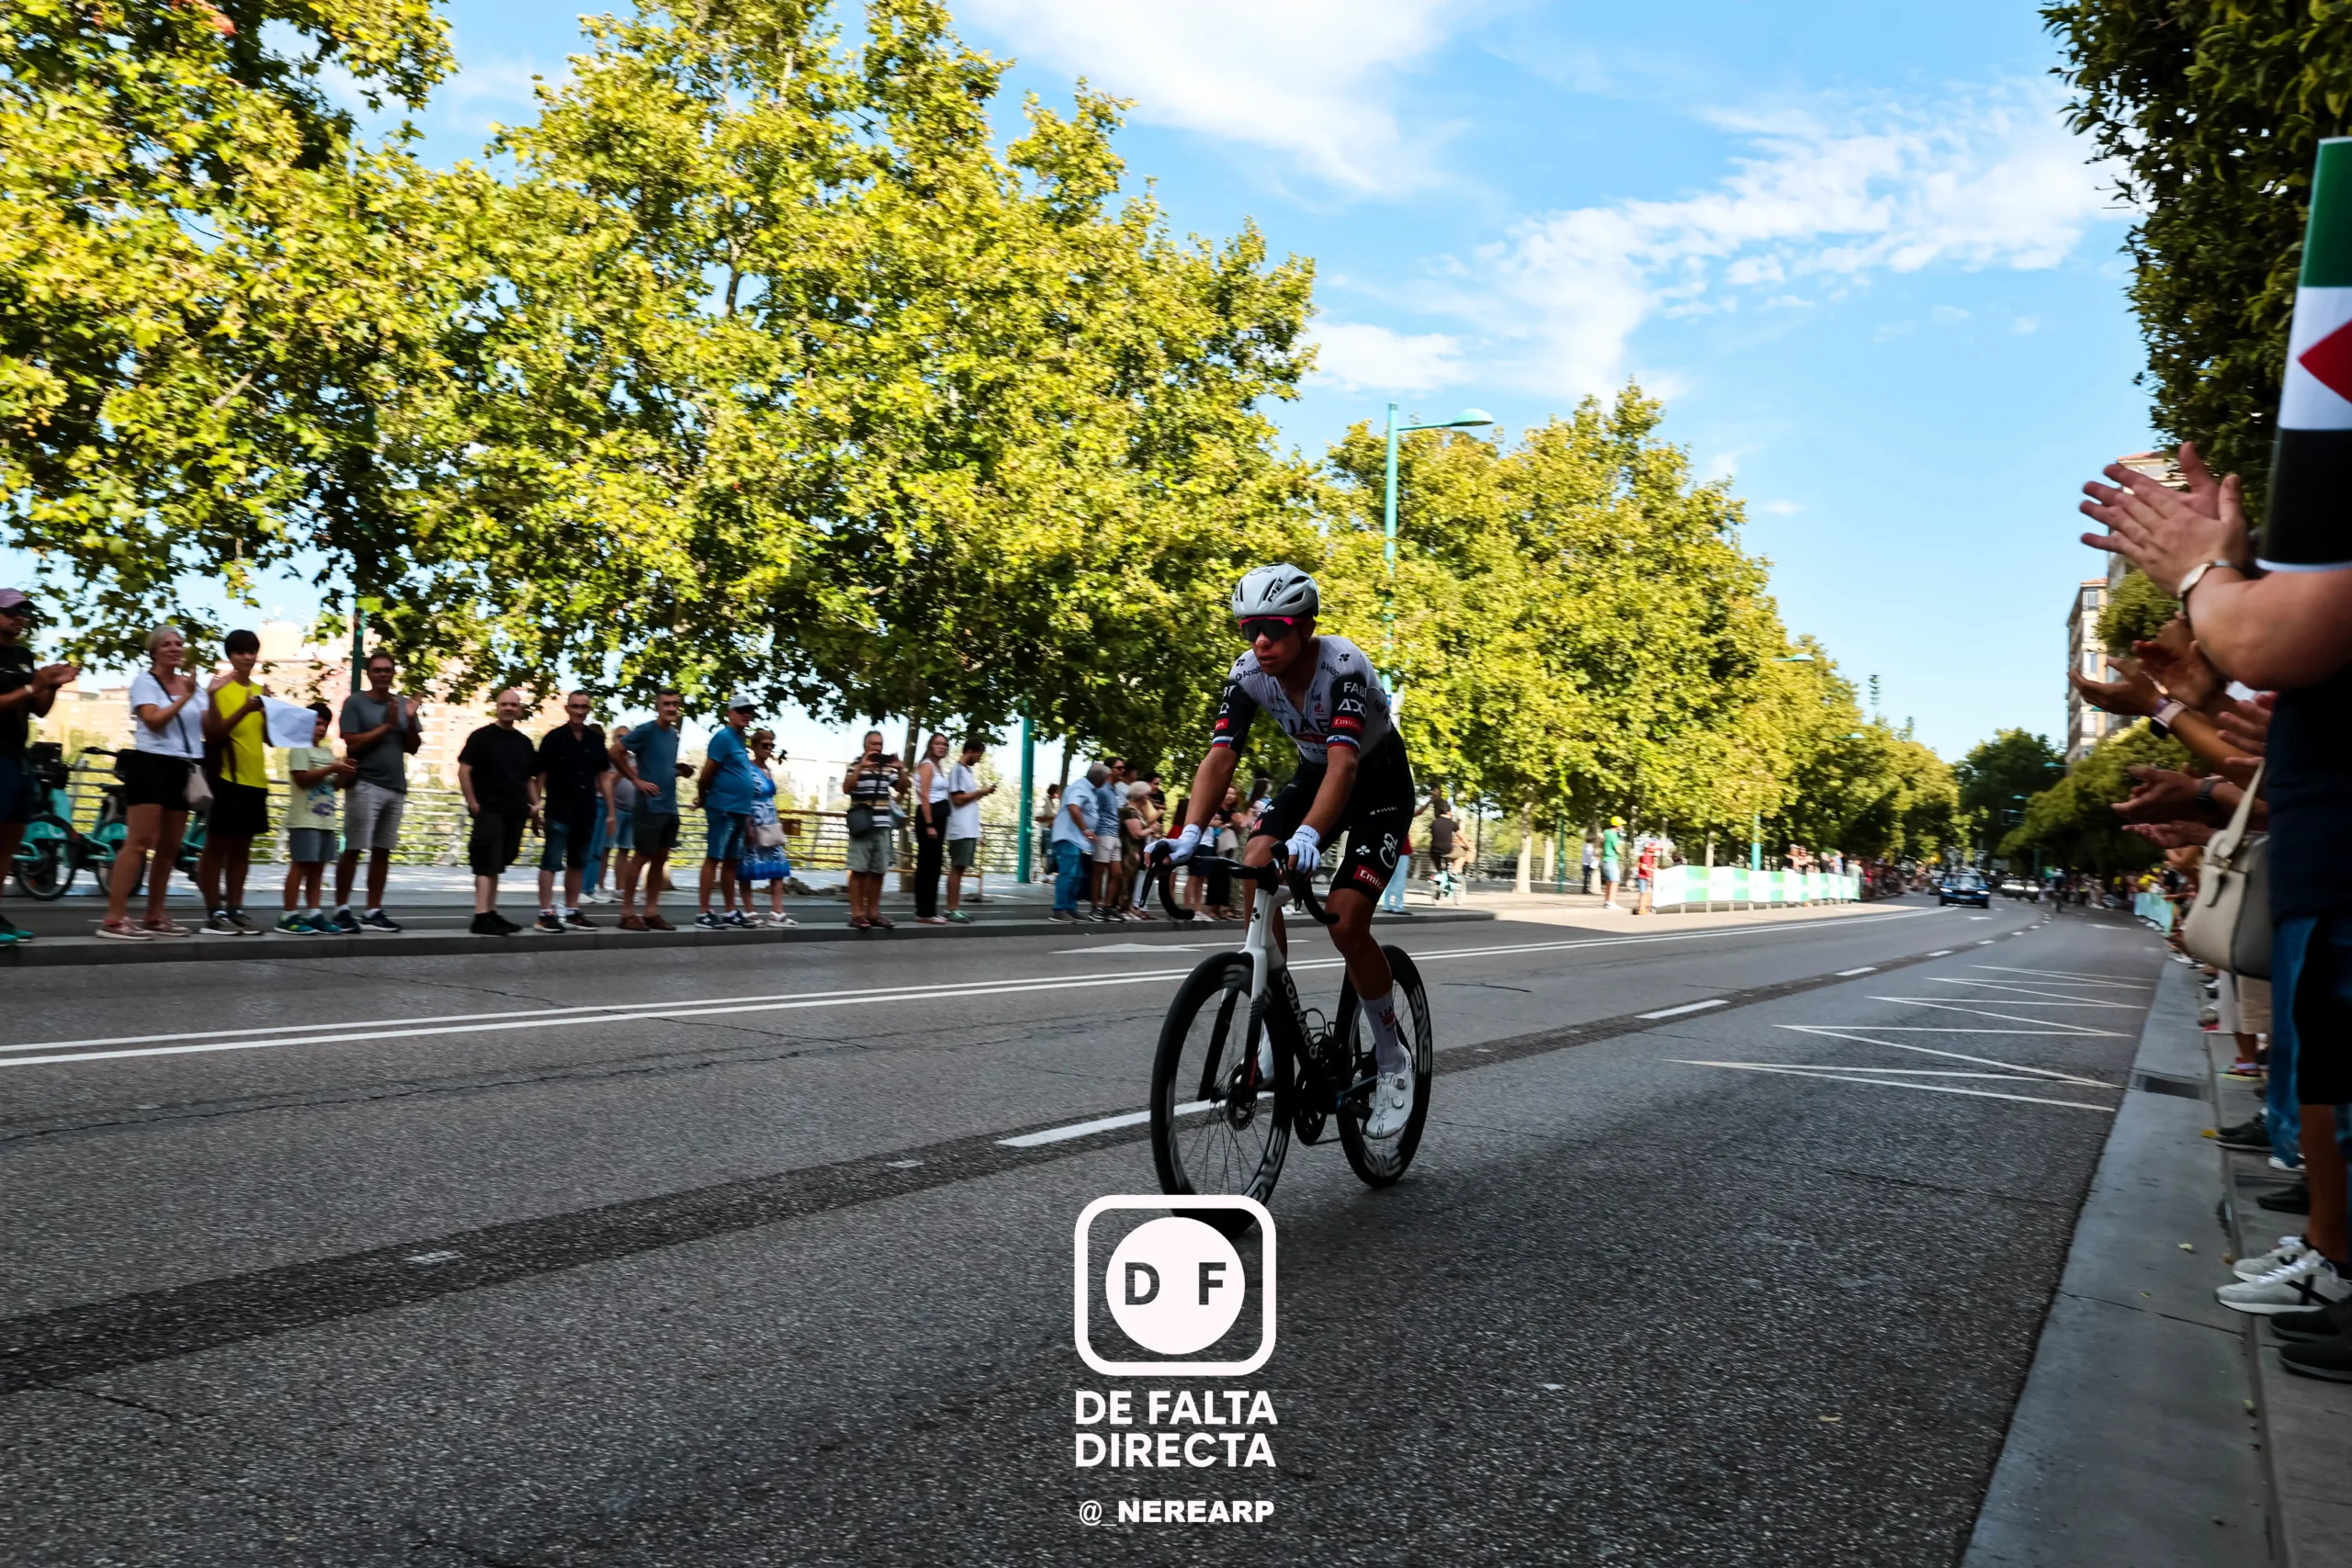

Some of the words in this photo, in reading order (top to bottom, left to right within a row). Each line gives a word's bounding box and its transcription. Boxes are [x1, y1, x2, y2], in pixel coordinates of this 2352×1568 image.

[1268, 577, 1283, 603] MET
[1379, 832, 1398, 870] G42
[1281, 971, 1317, 1061] COLNAGO
